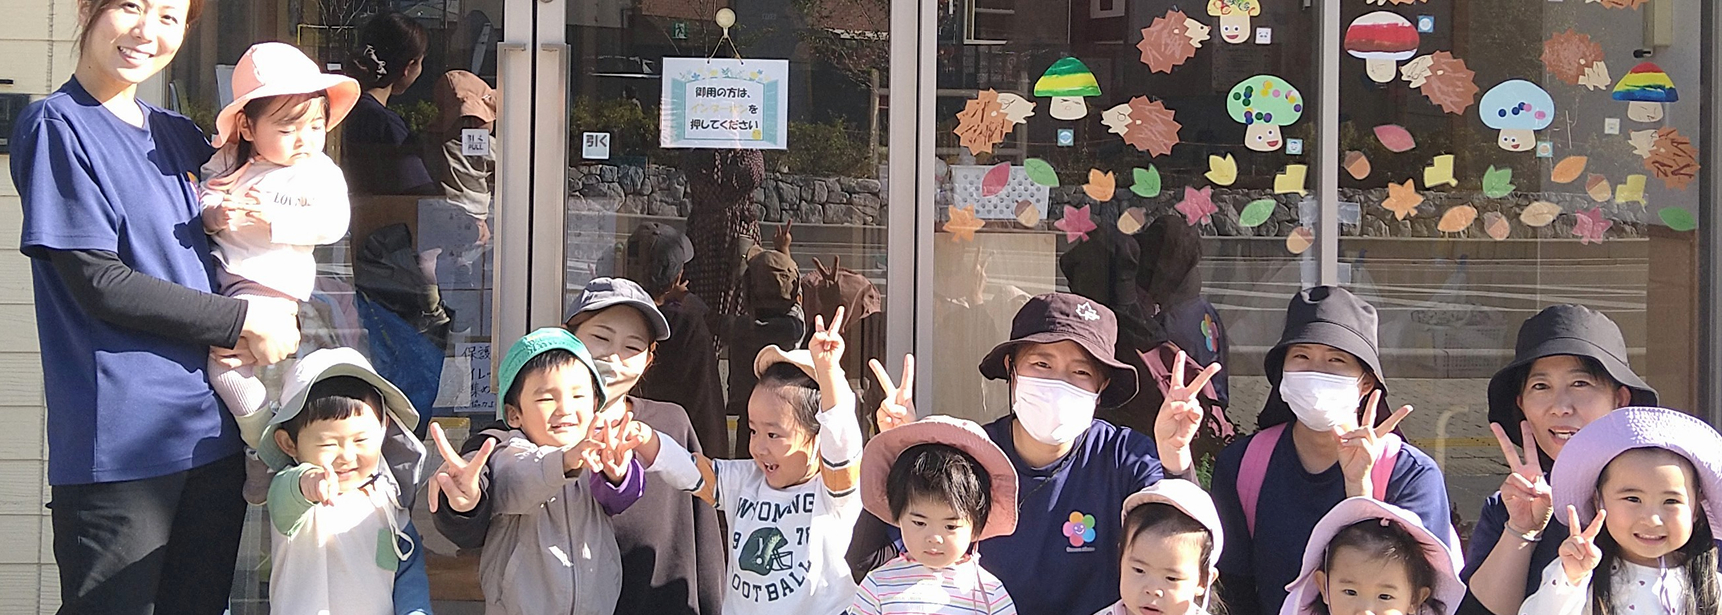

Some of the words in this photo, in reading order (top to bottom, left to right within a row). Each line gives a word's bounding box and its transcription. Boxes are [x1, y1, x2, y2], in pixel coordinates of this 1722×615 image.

[695, 86, 751, 98] 御用の方は、
[690, 119, 759, 130] 押してください
[467, 134, 484, 142] 引く
[586, 134, 607, 148] 引く
[736, 493, 815, 522] WYOMNG
[732, 560, 811, 602] OOTBALL
